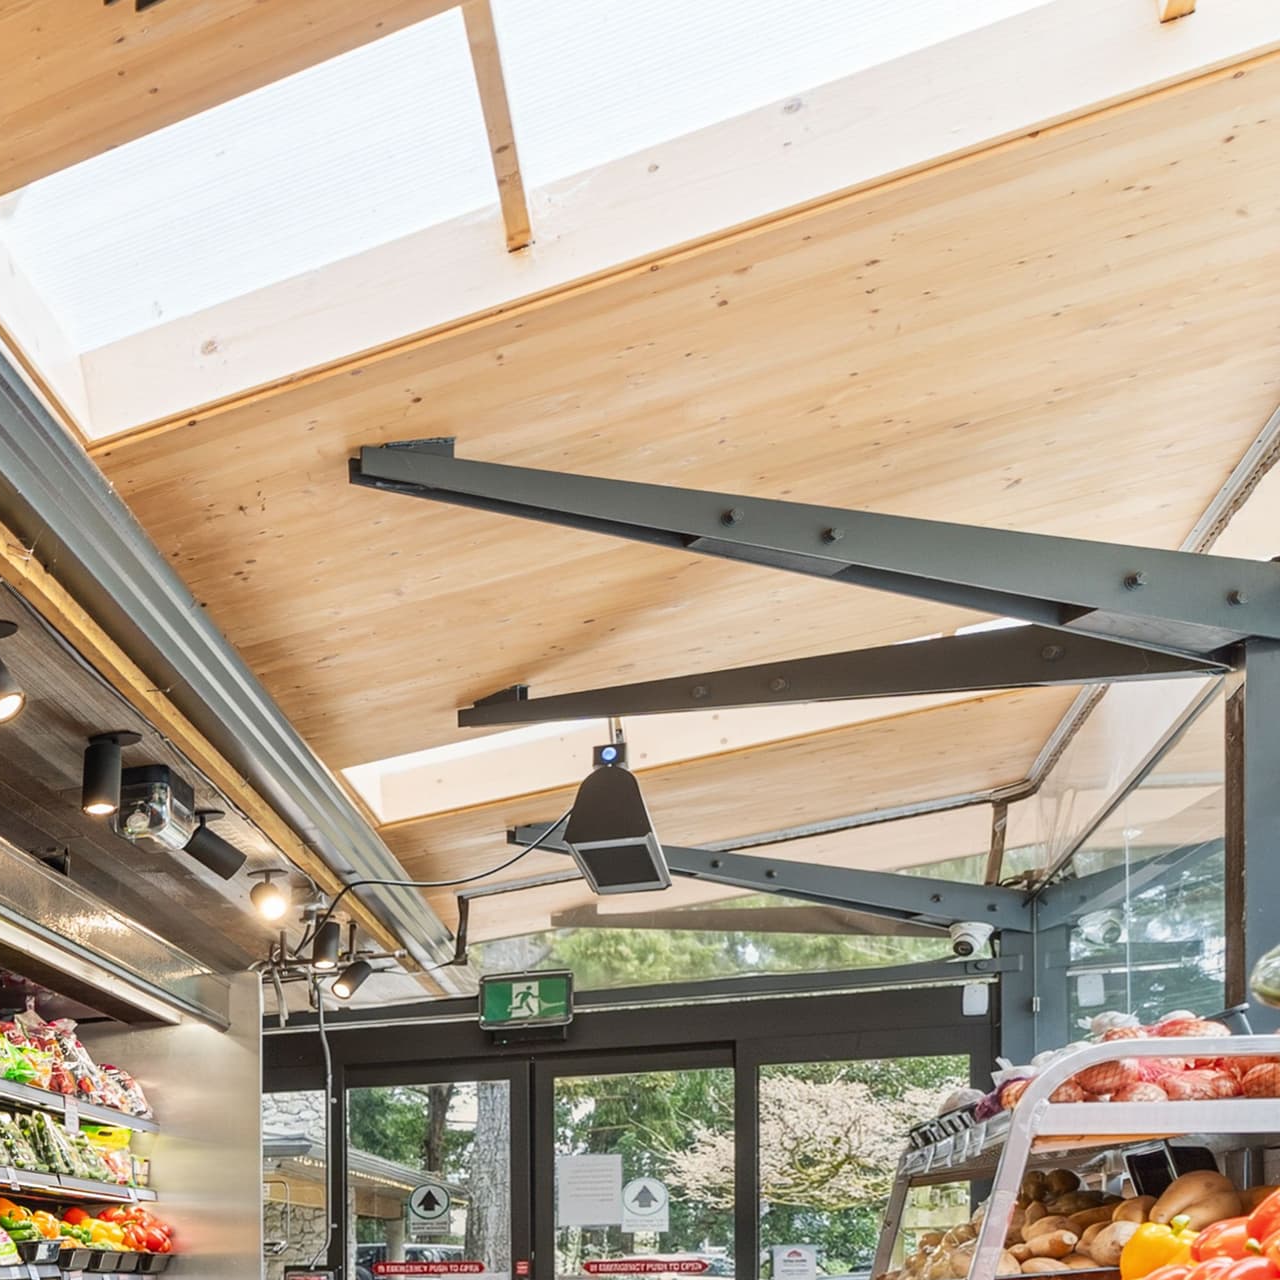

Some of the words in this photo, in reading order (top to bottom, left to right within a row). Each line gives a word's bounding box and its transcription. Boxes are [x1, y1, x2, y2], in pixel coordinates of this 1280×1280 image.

[386, 1263, 428, 1273] EMERGENCY
[428, 1263, 449, 1273] PUSH
[450, 1263, 458, 1273] TO
[459, 1263, 480, 1273] OPEN
[598, 1263, 645, 1273] EMERGENCY
[646, 1263, 668, 1272] PUSH
[669, 1262, 679, 1271] TO
[680, 1262, 702, 1271] OPEN
